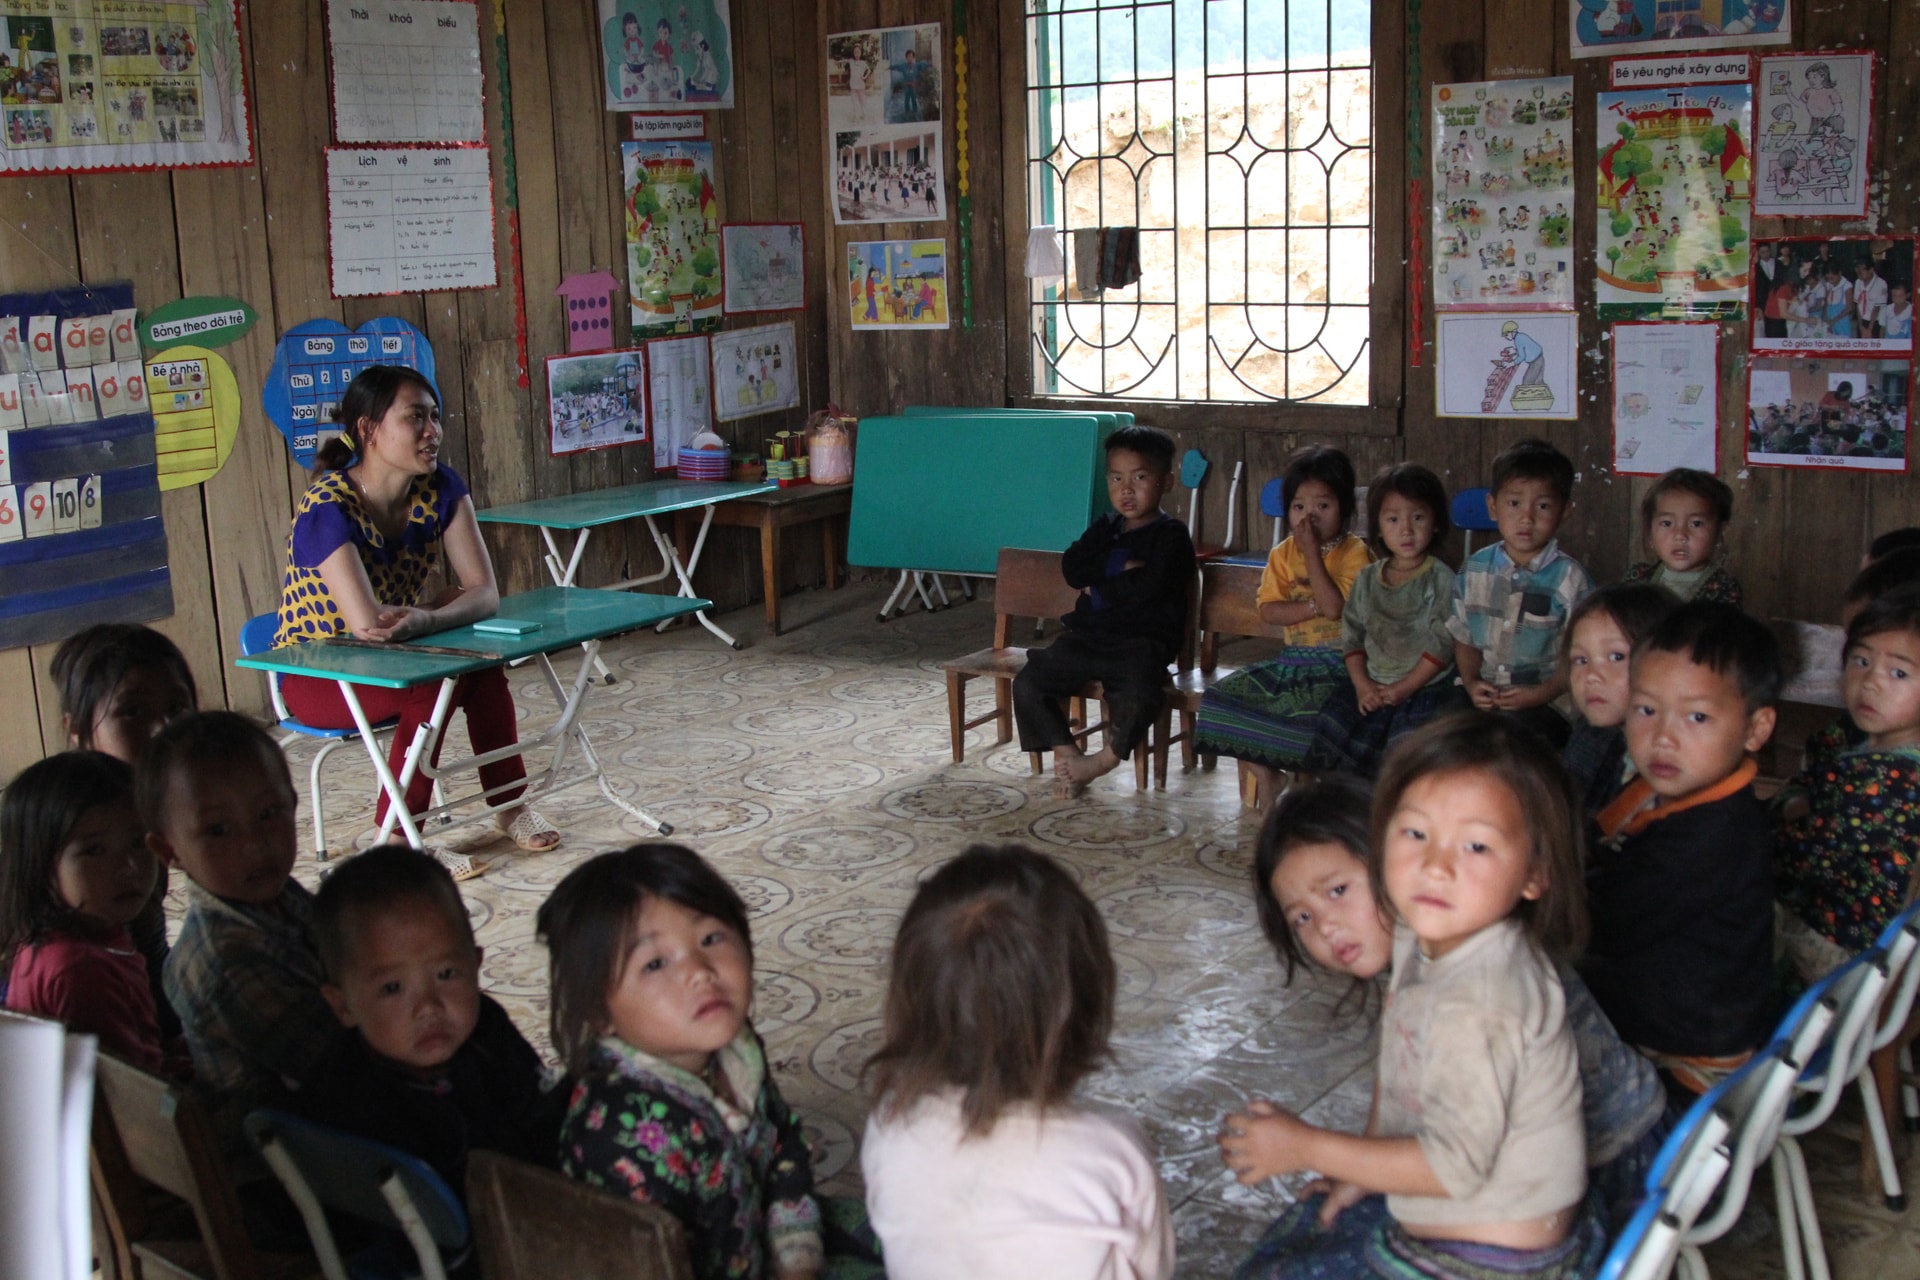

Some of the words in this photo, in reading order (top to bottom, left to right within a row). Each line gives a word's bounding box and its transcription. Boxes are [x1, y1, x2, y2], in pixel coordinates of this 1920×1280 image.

[350, 8, 369, 20] Thời
[1616, 67, 1629, 78] Bé
[1633, 67, 1653, 78] yêu
[1656, 63, 1685, 77] nghề
[1715, 63, 1747, 76] dựng
[634, 120, 644, 130] Bé
[358, 156, 378, 168] Lịch
[397, 155, 408, 167] vệ
[433, 156, 451, 166] sinh
[152, 324, 181, 338] Bảng
[183, 322, 207, 333] theo
[210, 315, 227, 328] dõi
[229, 311, 244, 324] trẻ
[34, 332, 53, 353] a
[67, 322, 87, 349] ă
[90, 327, 106, 346] e
[116, 318, 132, 343] d
[307, 339, 333, 352] Bảng
[350, 338, 367, 350] thời
[383, 338, 398, 350] tiết
[1795, 340, 1812, 348] giáo
[153, 365, 167, 377] Bé
[180, 362, 200, 374] nhà
[323, 373, 329, 383] 2
[344, 371, 350, 381] 3
[68, 383, 93, 402] m
[127, 375, 143, 402] g
[292, 406, 317, 418] Ngày
[294, 436, 317, 448] Sáng
[30, 494, 46, 520] 9
[56, 491, 76, 519] 10
[85, 488, 95, 509] 8
